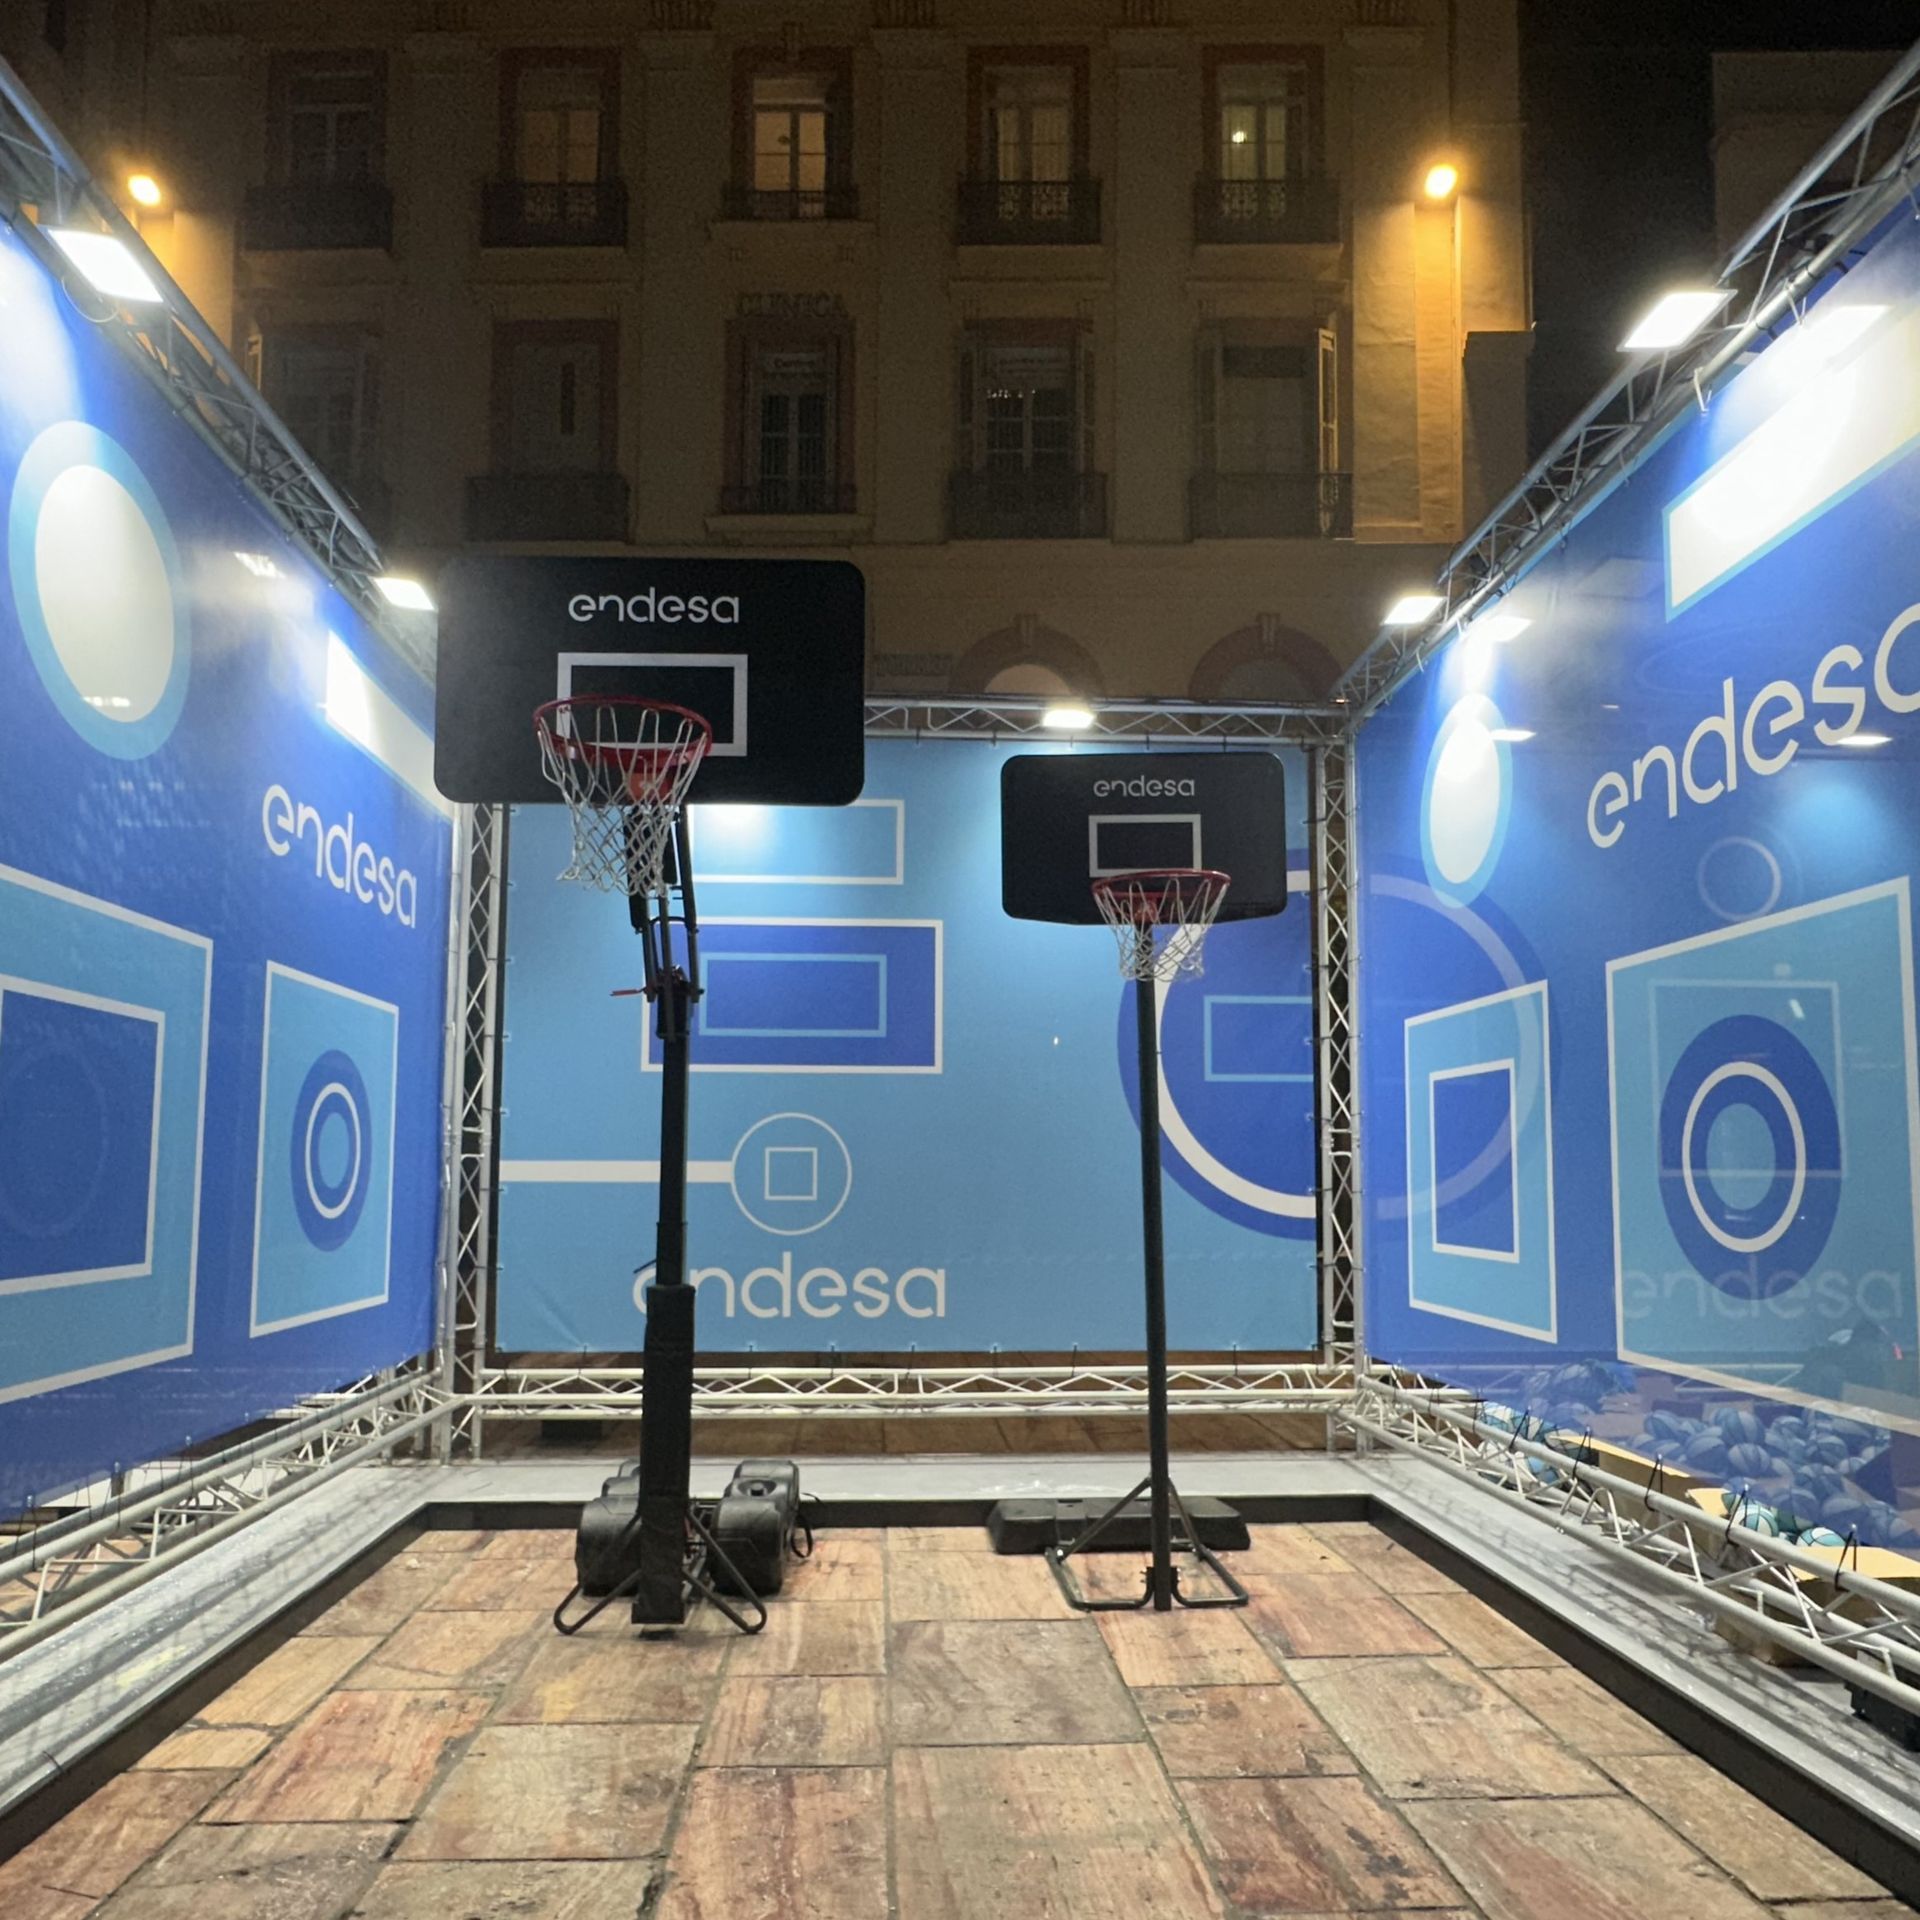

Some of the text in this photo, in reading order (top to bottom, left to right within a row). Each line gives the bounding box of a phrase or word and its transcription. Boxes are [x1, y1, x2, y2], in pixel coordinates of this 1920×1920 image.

[568, 587, 739, 623] endesa
[1093, 775, 1195, 797] endesa
[262, 784, 417, 928] endesa
[1623, 1253, 1904, 1320] endesa
